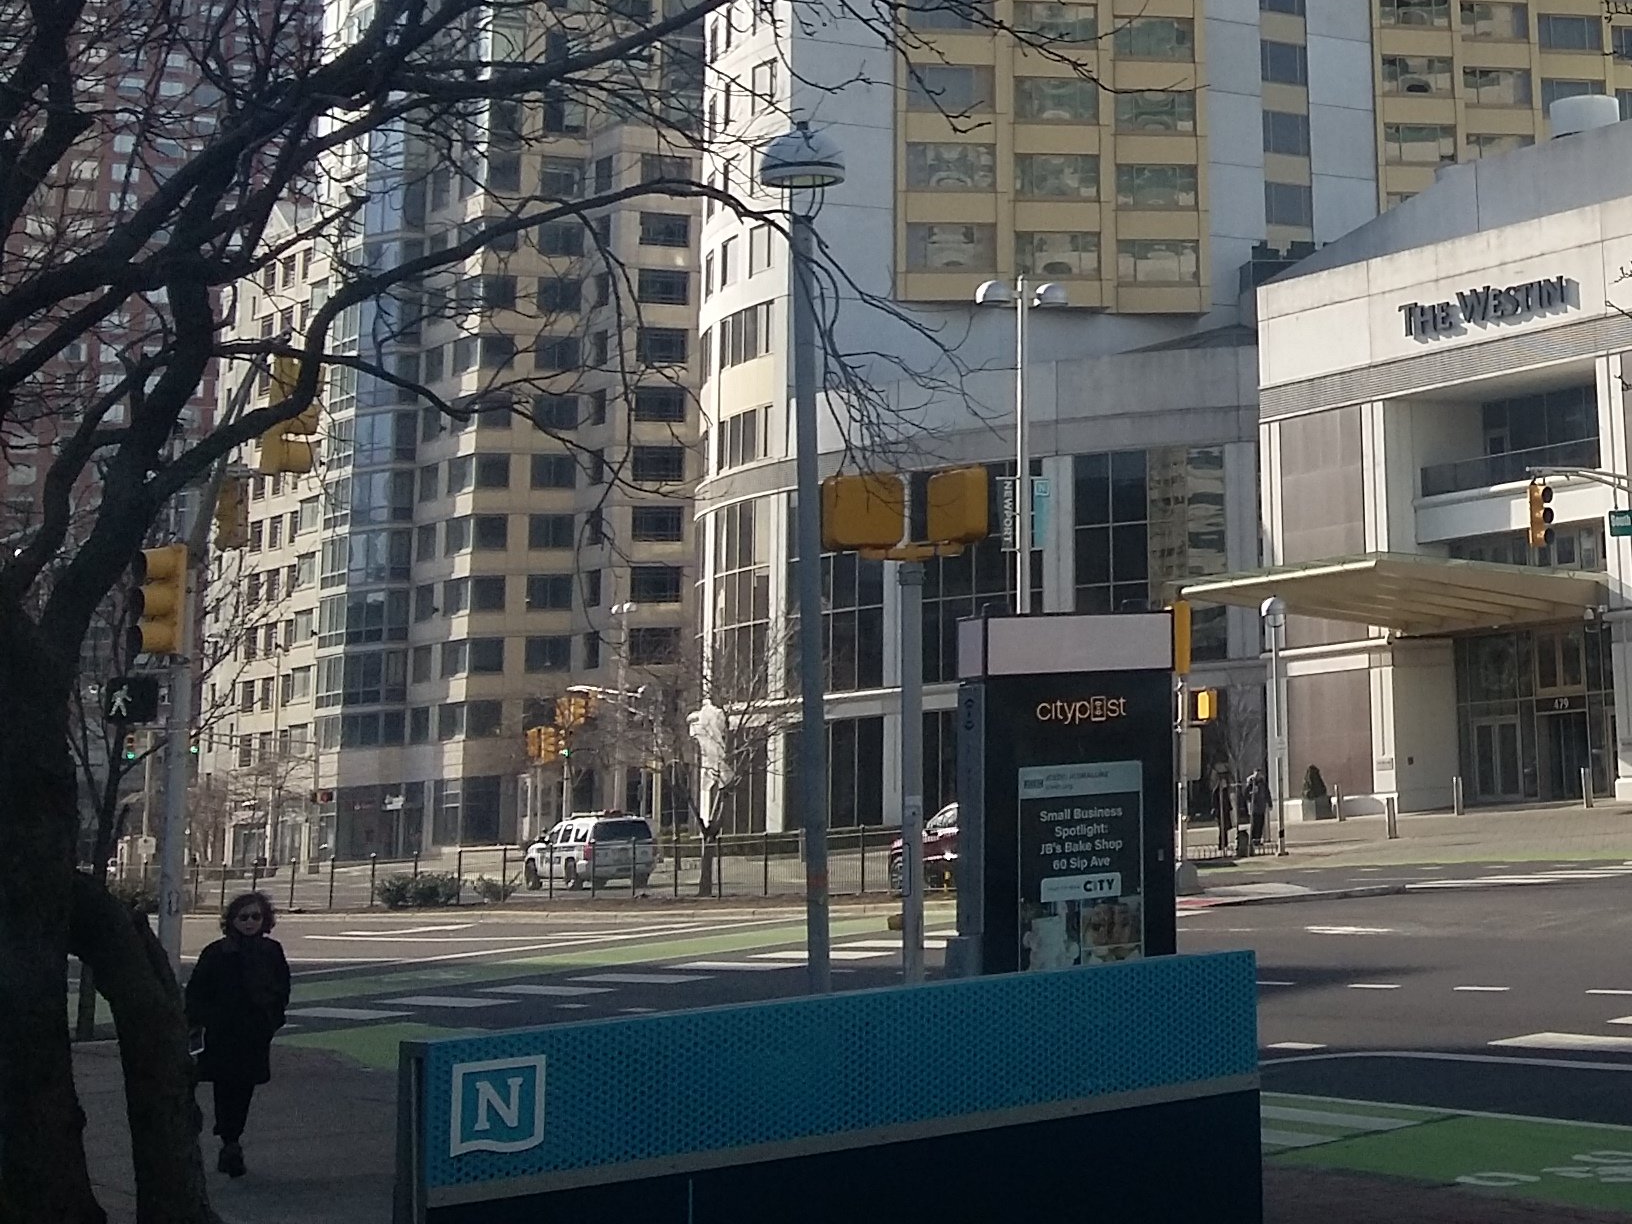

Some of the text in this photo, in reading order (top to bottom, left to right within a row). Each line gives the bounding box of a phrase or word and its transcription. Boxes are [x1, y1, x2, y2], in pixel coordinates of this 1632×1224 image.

[1398, 275, 1564, 337] THE WESTIN
[1003, 480, 1013, 543] NEWPORT
[1610, 514, 1631, 527] South
[1554, 697, 1569, 710] 479
[1040, 806, 1123, 822] Small Business
[1054, 823, 1108, 839] Spotlight:
[1040, 838, 1123, 855] JB's Bake Shop
[1053, 859, 1067, 870] 60
[1090, 855, 1111, 867] Ave
[473, 1076, 524, 1131] N
